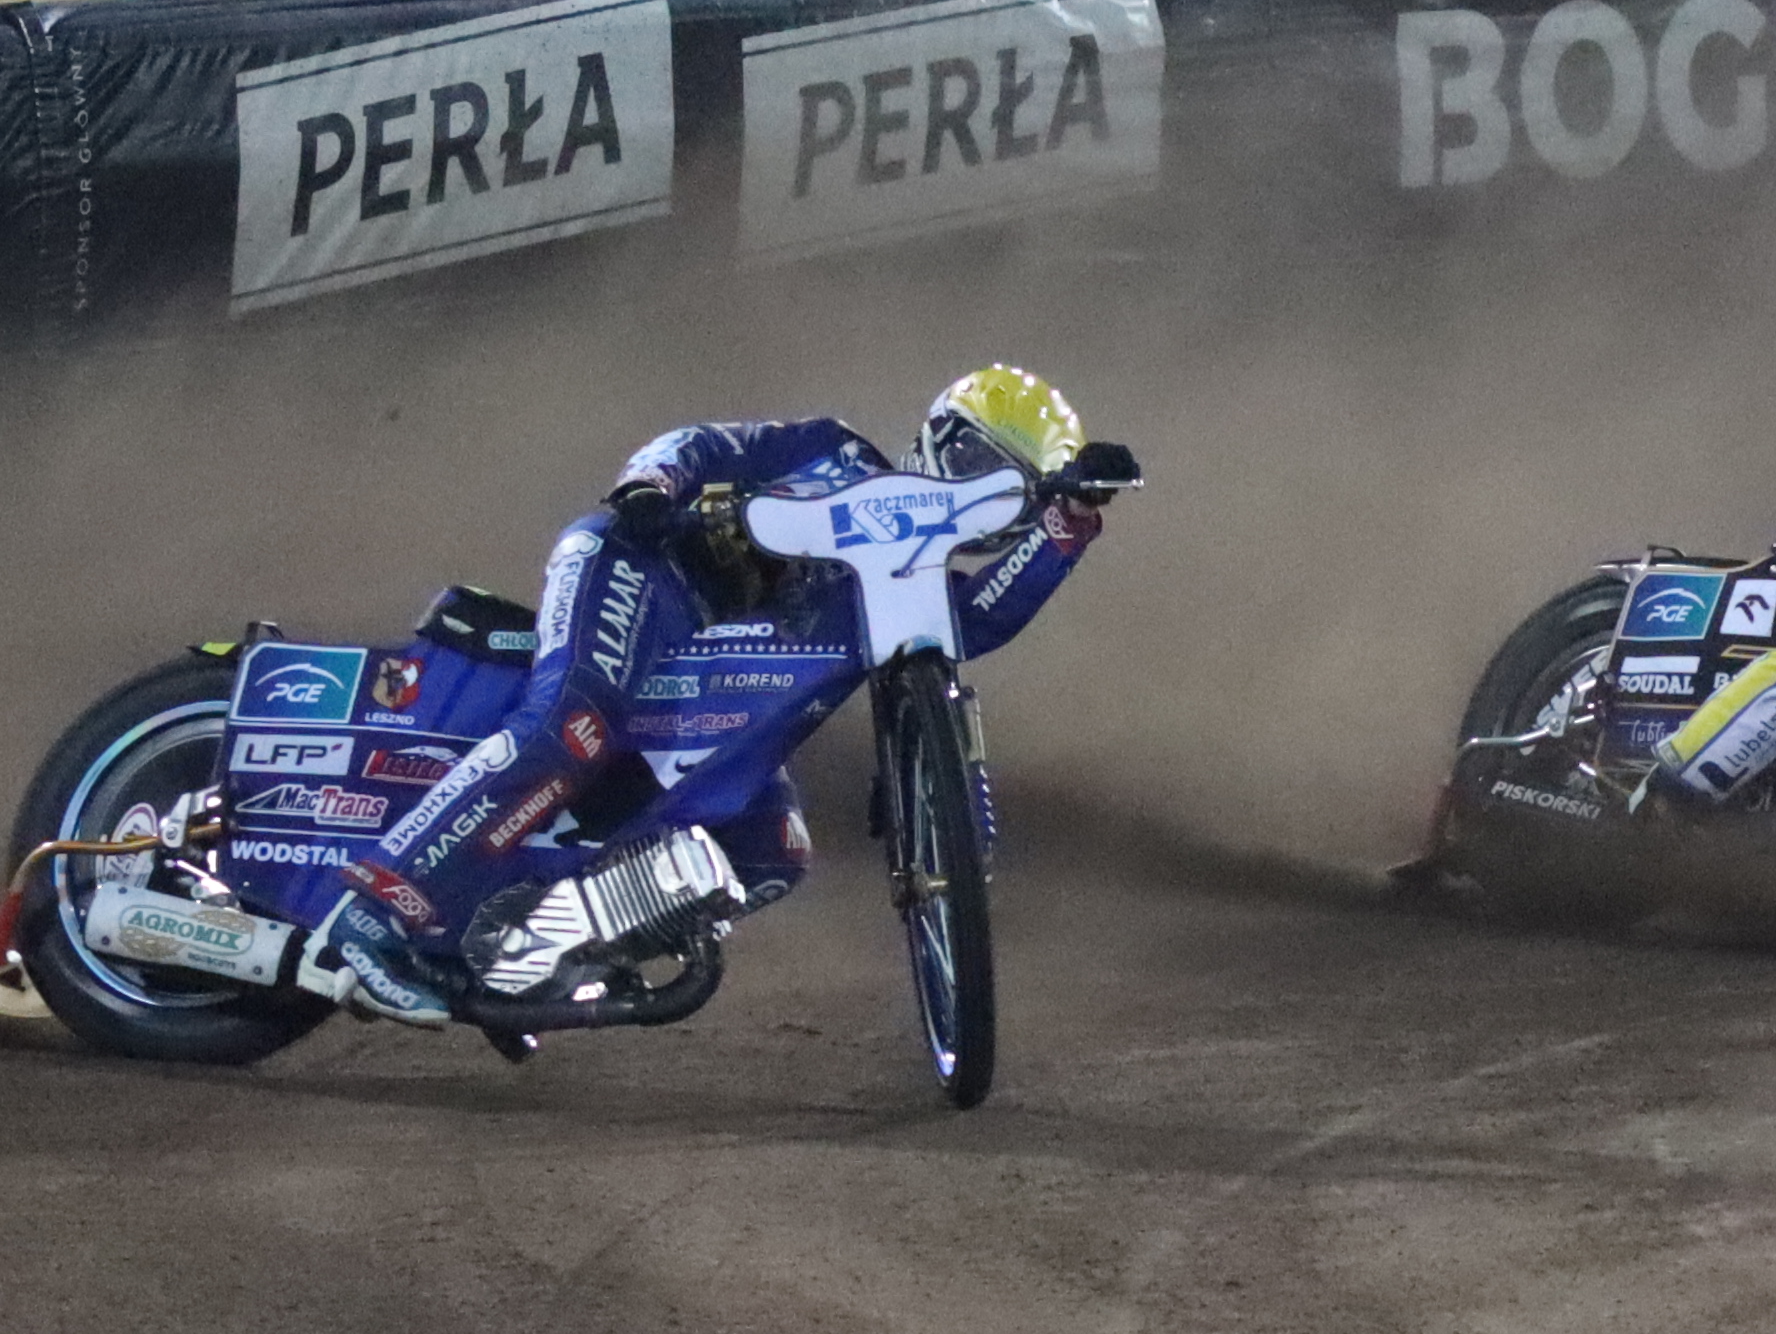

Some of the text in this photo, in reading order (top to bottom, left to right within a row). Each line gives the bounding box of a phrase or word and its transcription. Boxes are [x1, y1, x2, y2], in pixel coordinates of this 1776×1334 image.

[791, 34, 1115, 198] PERŁA
[289, 52, 622, 236] PERŁA
[73, 178, 93, 310] SPONSOR
[971, 526, 1049, 611] WODSTAL
[592, 559, 645, 685] ALMAR
[1647, 606, 1693, 622] PGE
[267, 684, 326, 702] PGE
[723, 673, 795, 687] KOREND
[1620, 676, 1694, 694] SOUDAL
[364, 711, 415, 725] LESZNO
[245, 744, 327, 766] LFP
[276, 785, 388, 818] MacTrans
[388, 765, 481, 855] FLIXHOME
[488, 779, 565, 847] BECKHOFF
[1491, 780, 1601, 819] PISKORSKI
[230, 840, 352, 867] WODSTAL
[128, 910, 243, 952] AGROMIX
